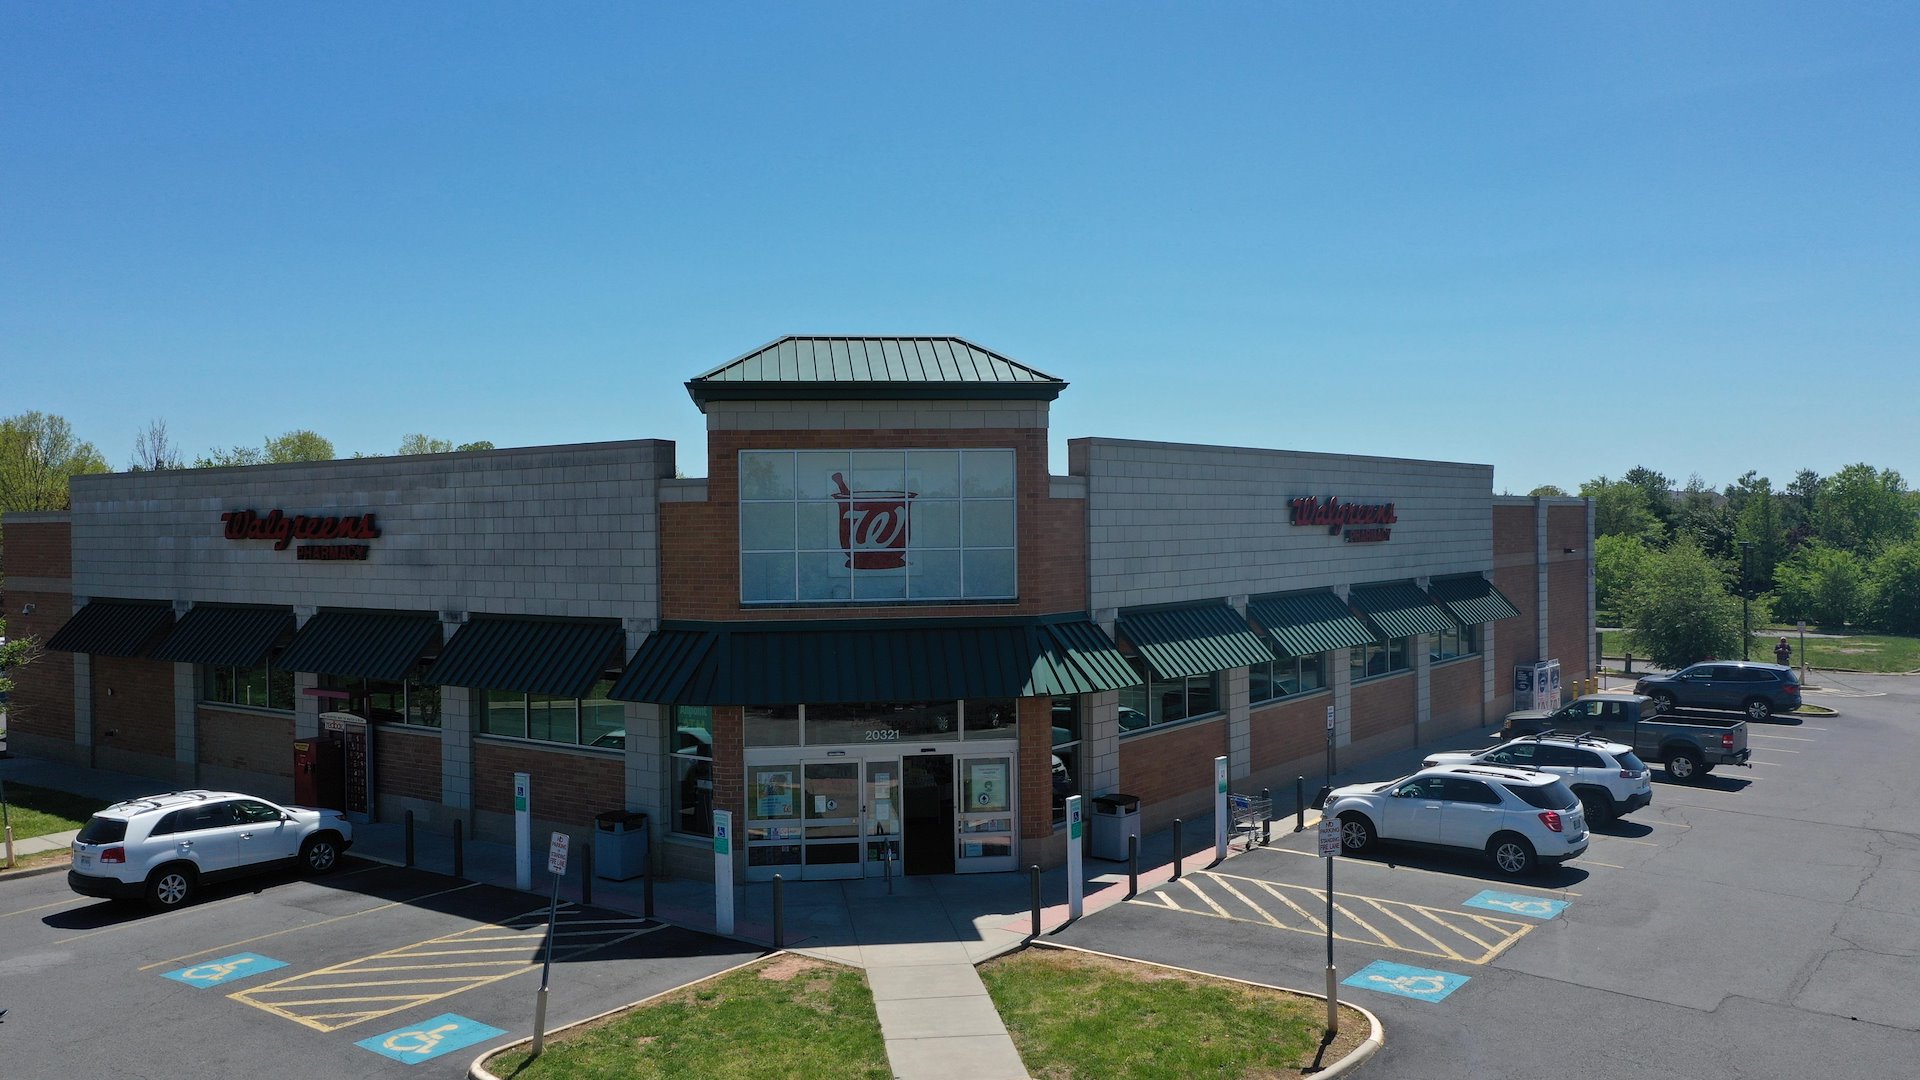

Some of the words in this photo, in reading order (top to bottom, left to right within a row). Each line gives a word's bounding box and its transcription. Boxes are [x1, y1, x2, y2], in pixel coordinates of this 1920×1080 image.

[1289, 496, 1397, 535] Walgreens
[221, 508, 380, 550] Walgreens
[1346, 528, 1391, 542] PHARMACY
[297, 546, 369, 560] PHARMACY
[865, 729, 900, 741] 20321
